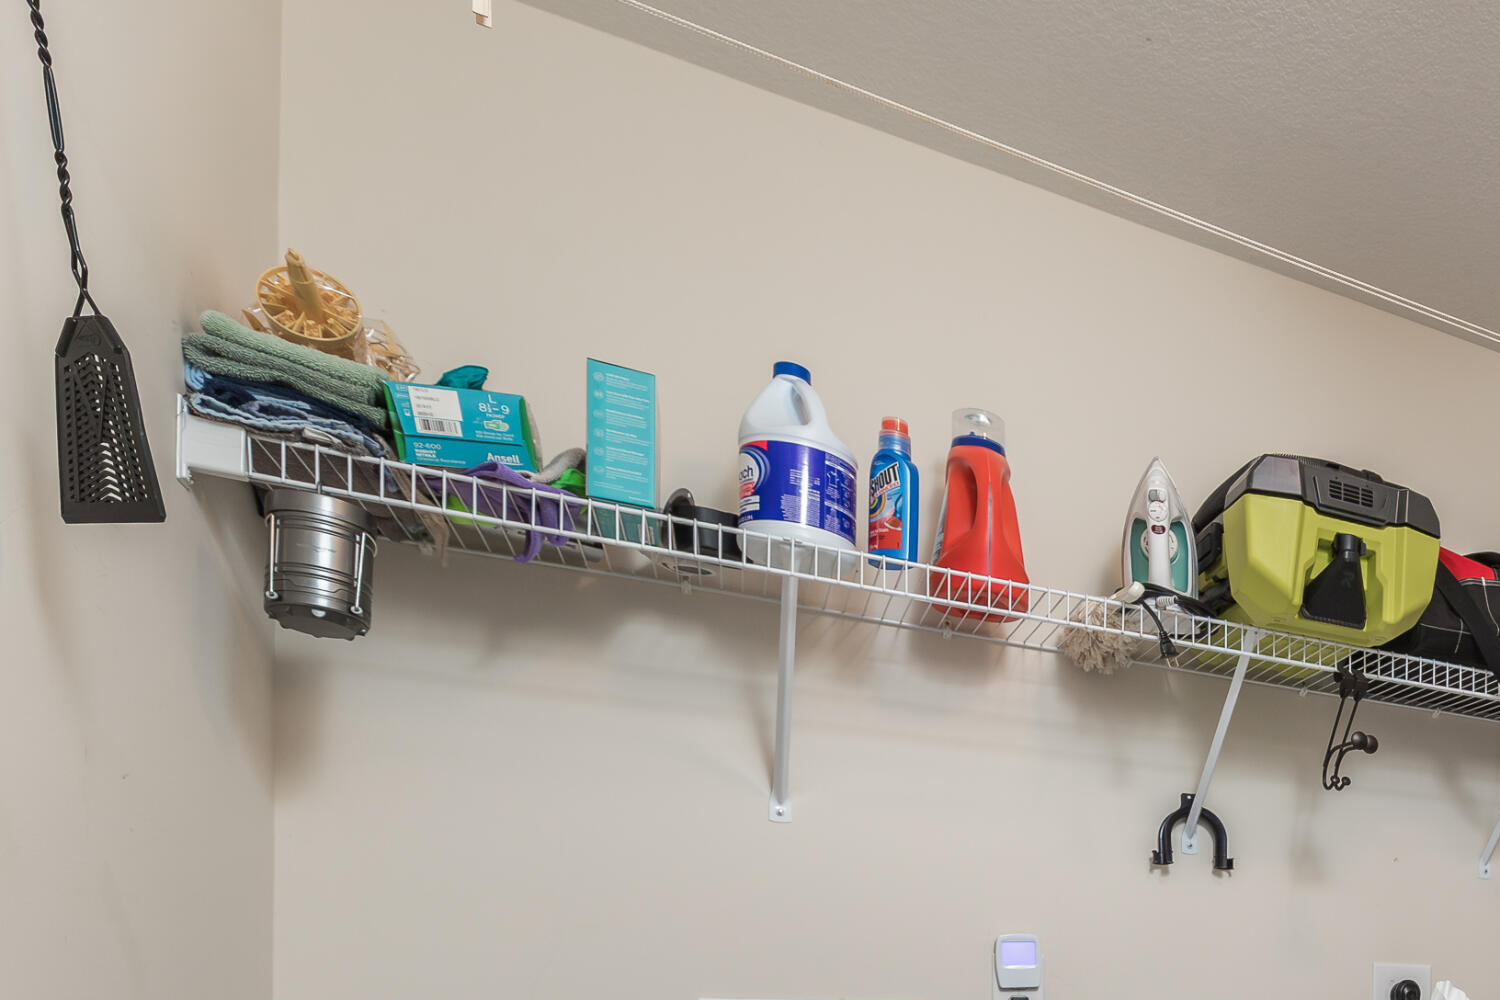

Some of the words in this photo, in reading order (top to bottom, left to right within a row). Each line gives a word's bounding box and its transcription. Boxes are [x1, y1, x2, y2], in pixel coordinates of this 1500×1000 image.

[488, 393, 497, 404] L
[487, 452, 520, 465] Ansell
[871, 463, 898, 497] SHOUT
